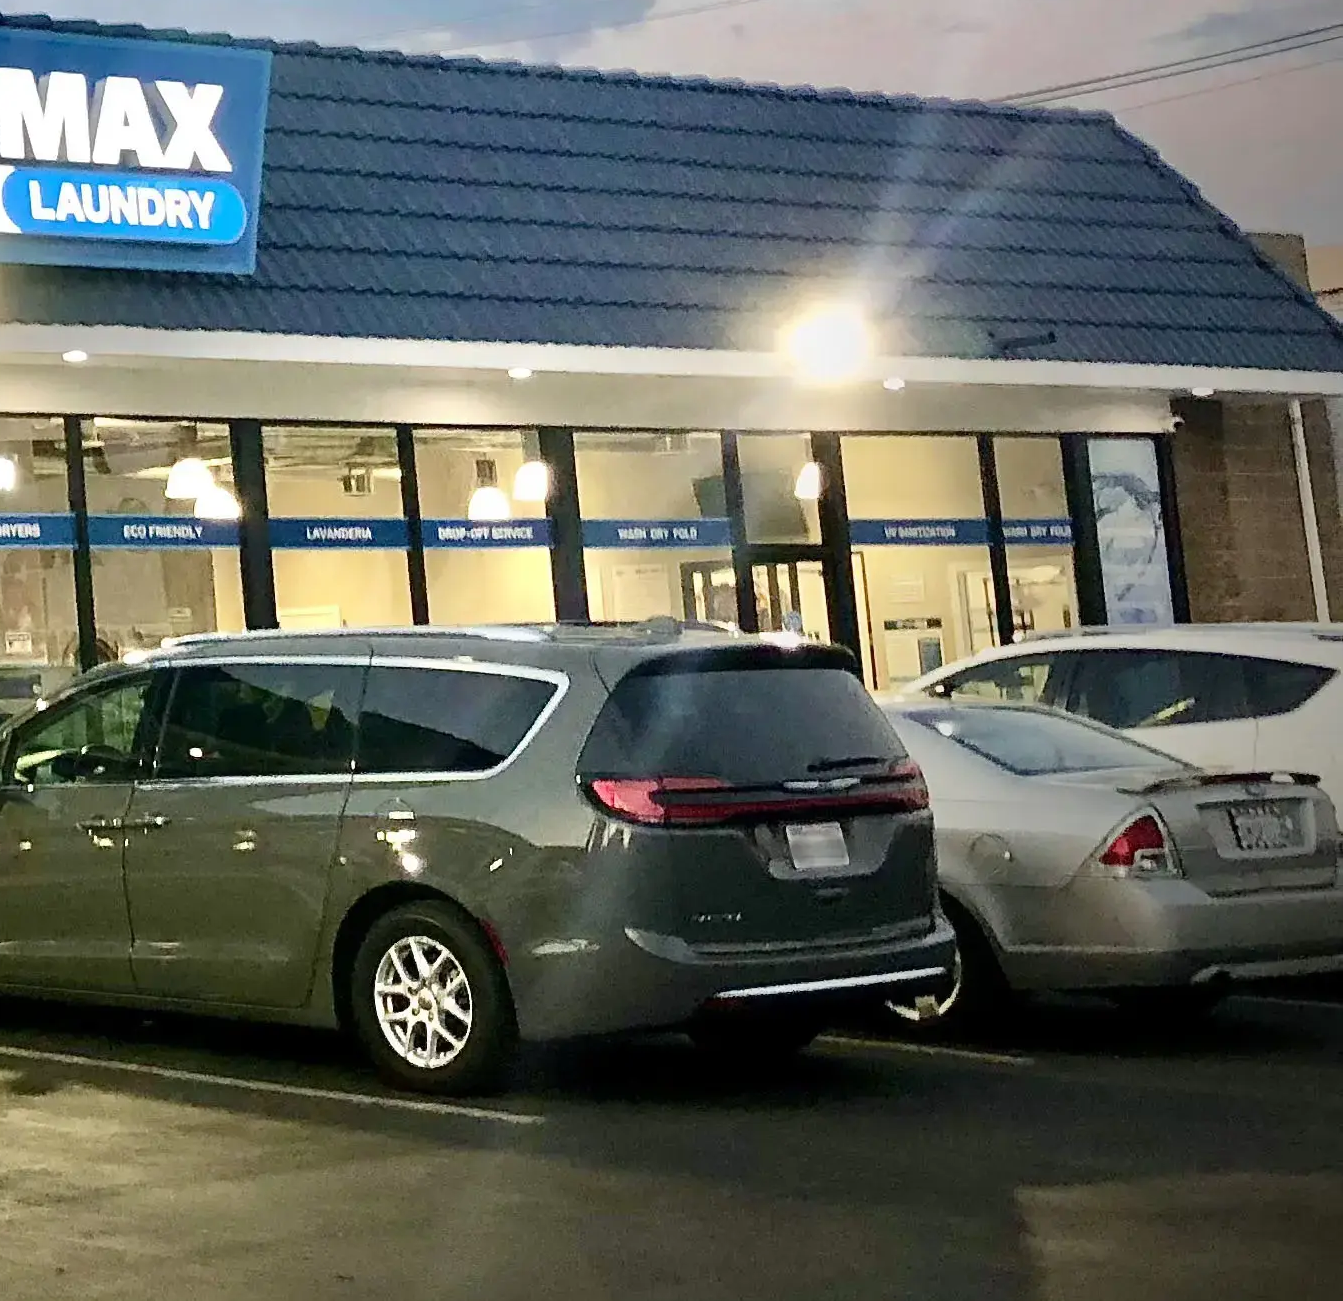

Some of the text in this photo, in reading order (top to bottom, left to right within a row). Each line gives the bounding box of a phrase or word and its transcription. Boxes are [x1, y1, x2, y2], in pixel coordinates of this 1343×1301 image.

[28, 179, 215, 230] LAUNDRY
[123, 524, 203, 540] ECO FRIENDLY
[306, 525, 373, 541] LAVANDERIA
[491, 526, 534, 540] SERVICE
